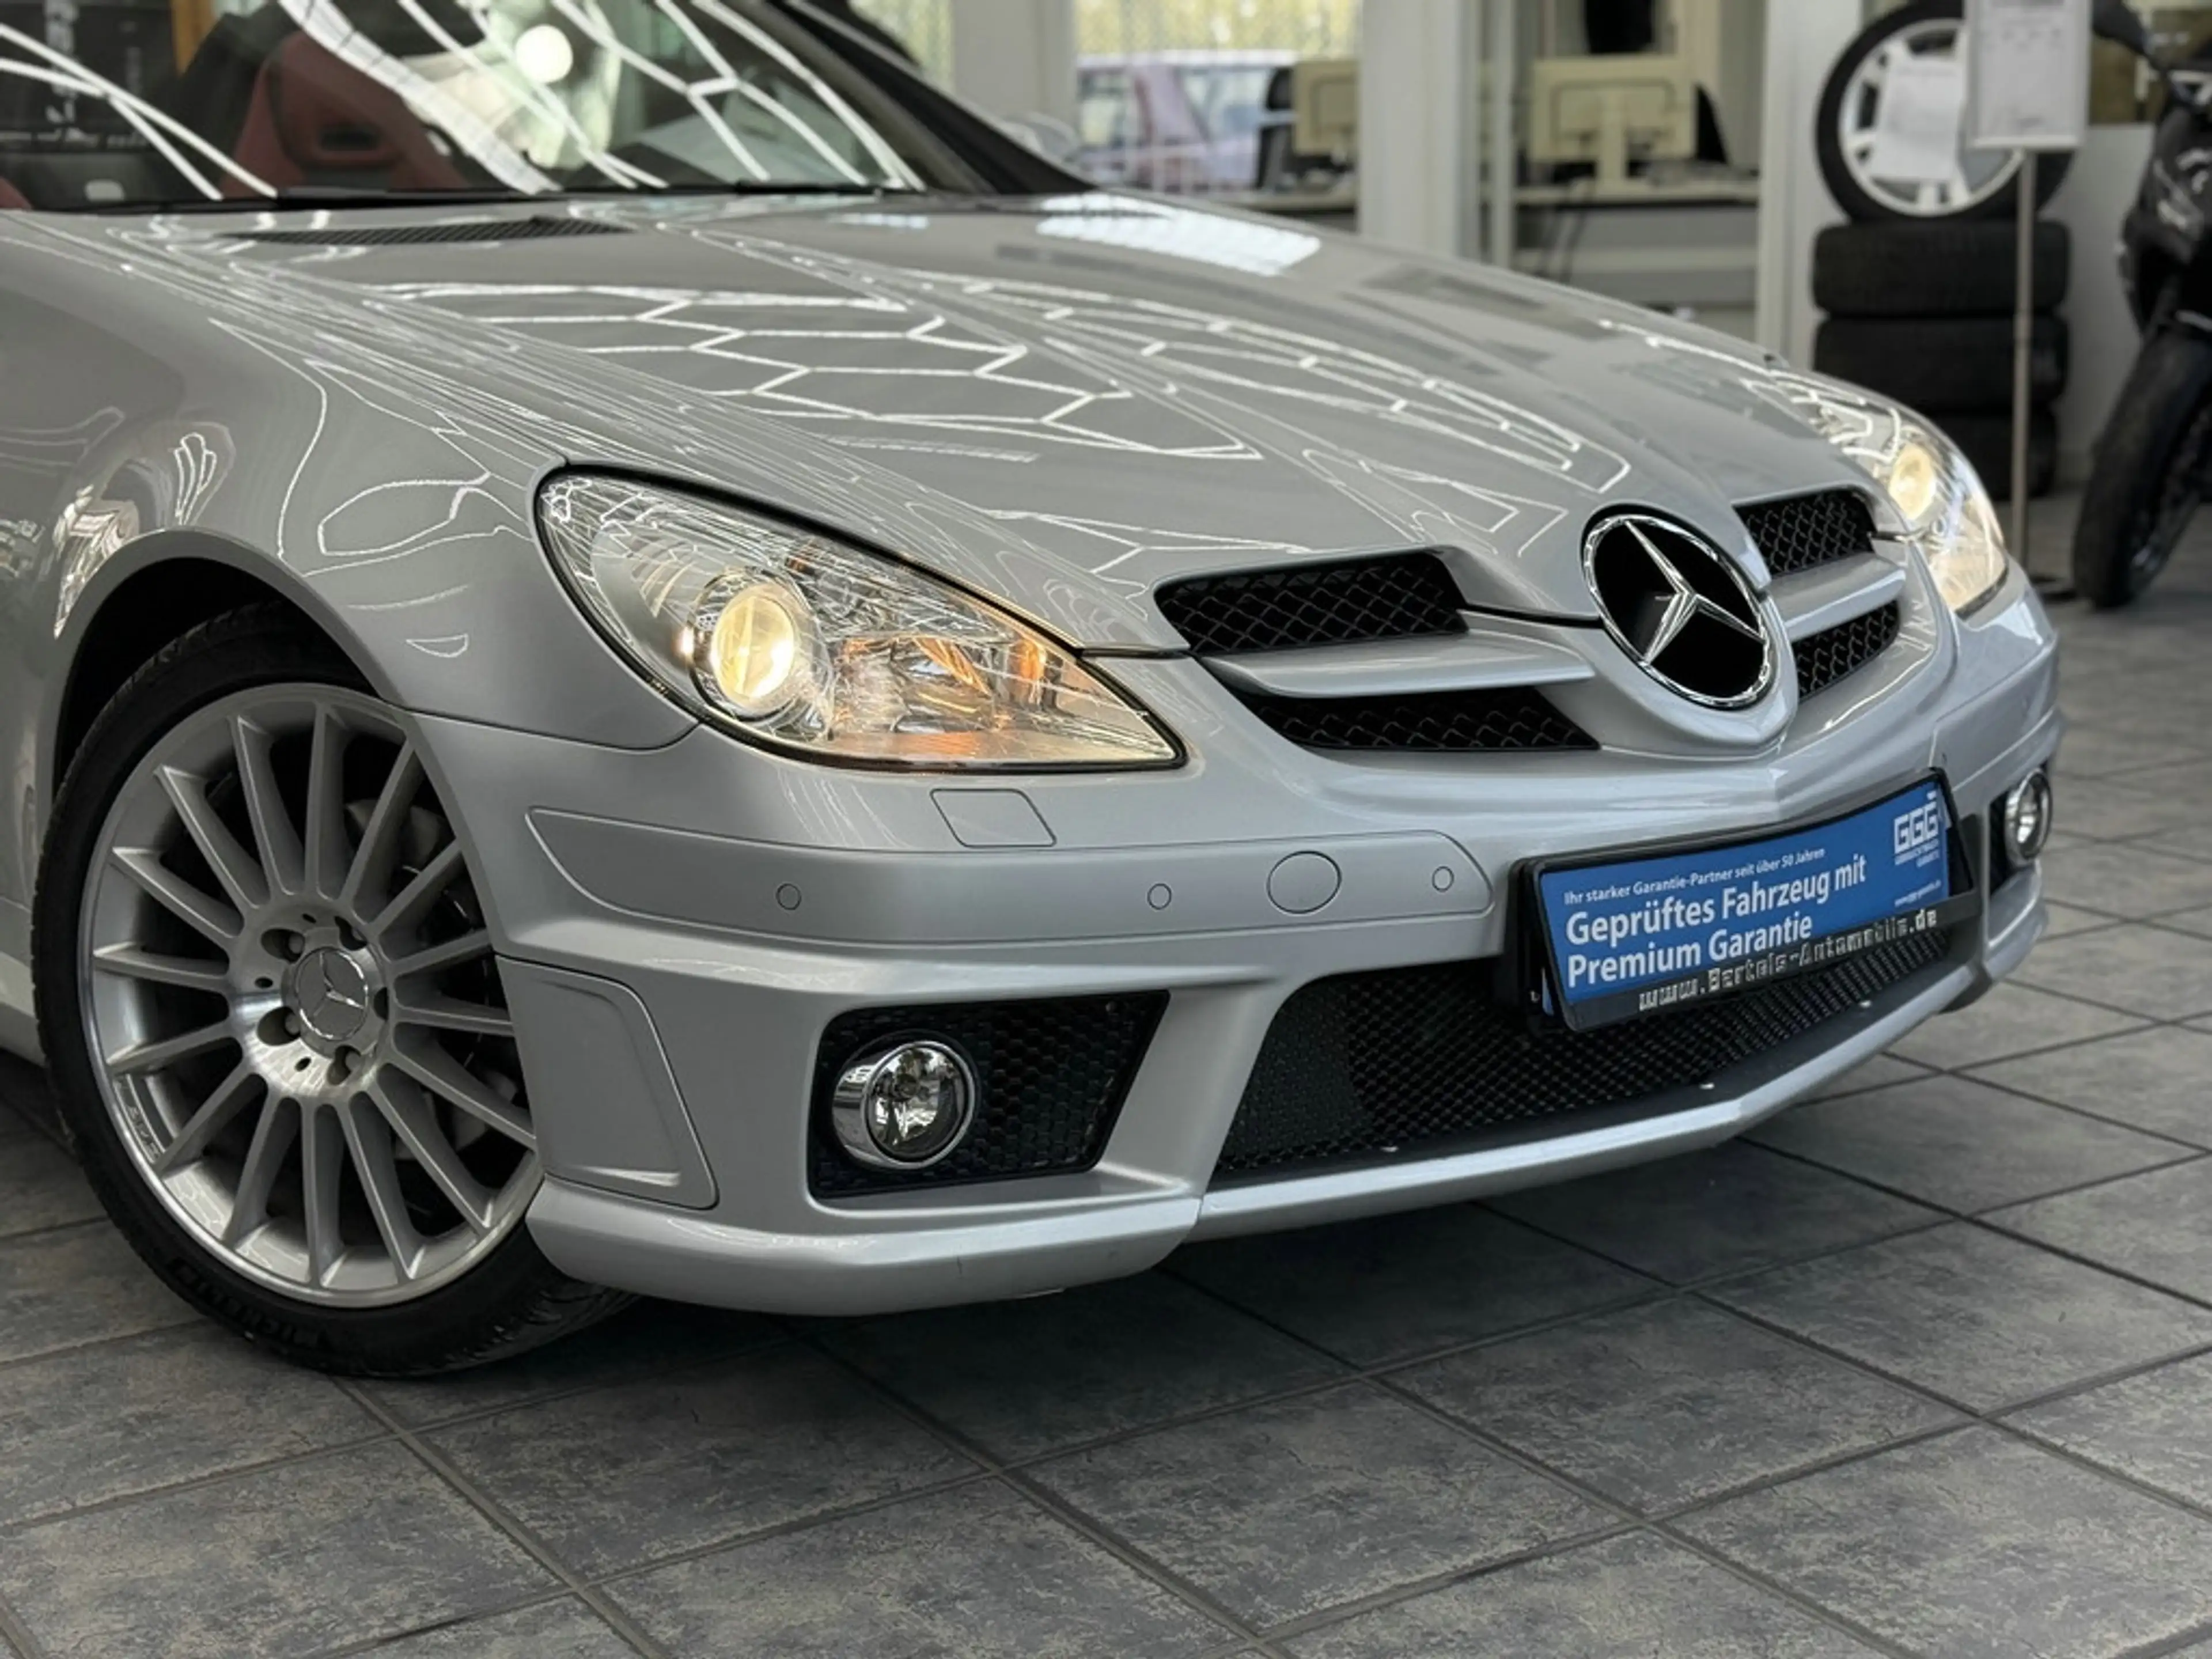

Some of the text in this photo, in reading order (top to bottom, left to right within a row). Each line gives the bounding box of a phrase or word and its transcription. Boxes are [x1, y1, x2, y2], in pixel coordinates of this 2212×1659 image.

[1564, 848, 1826, 905] Ihr starker Garantie-Partner seit über 50 Jahren
[1566, 853, 1868, 948] Geprüftes Fahrzeug mit
[1567, 910, 1813, 988] Premium Garantie
